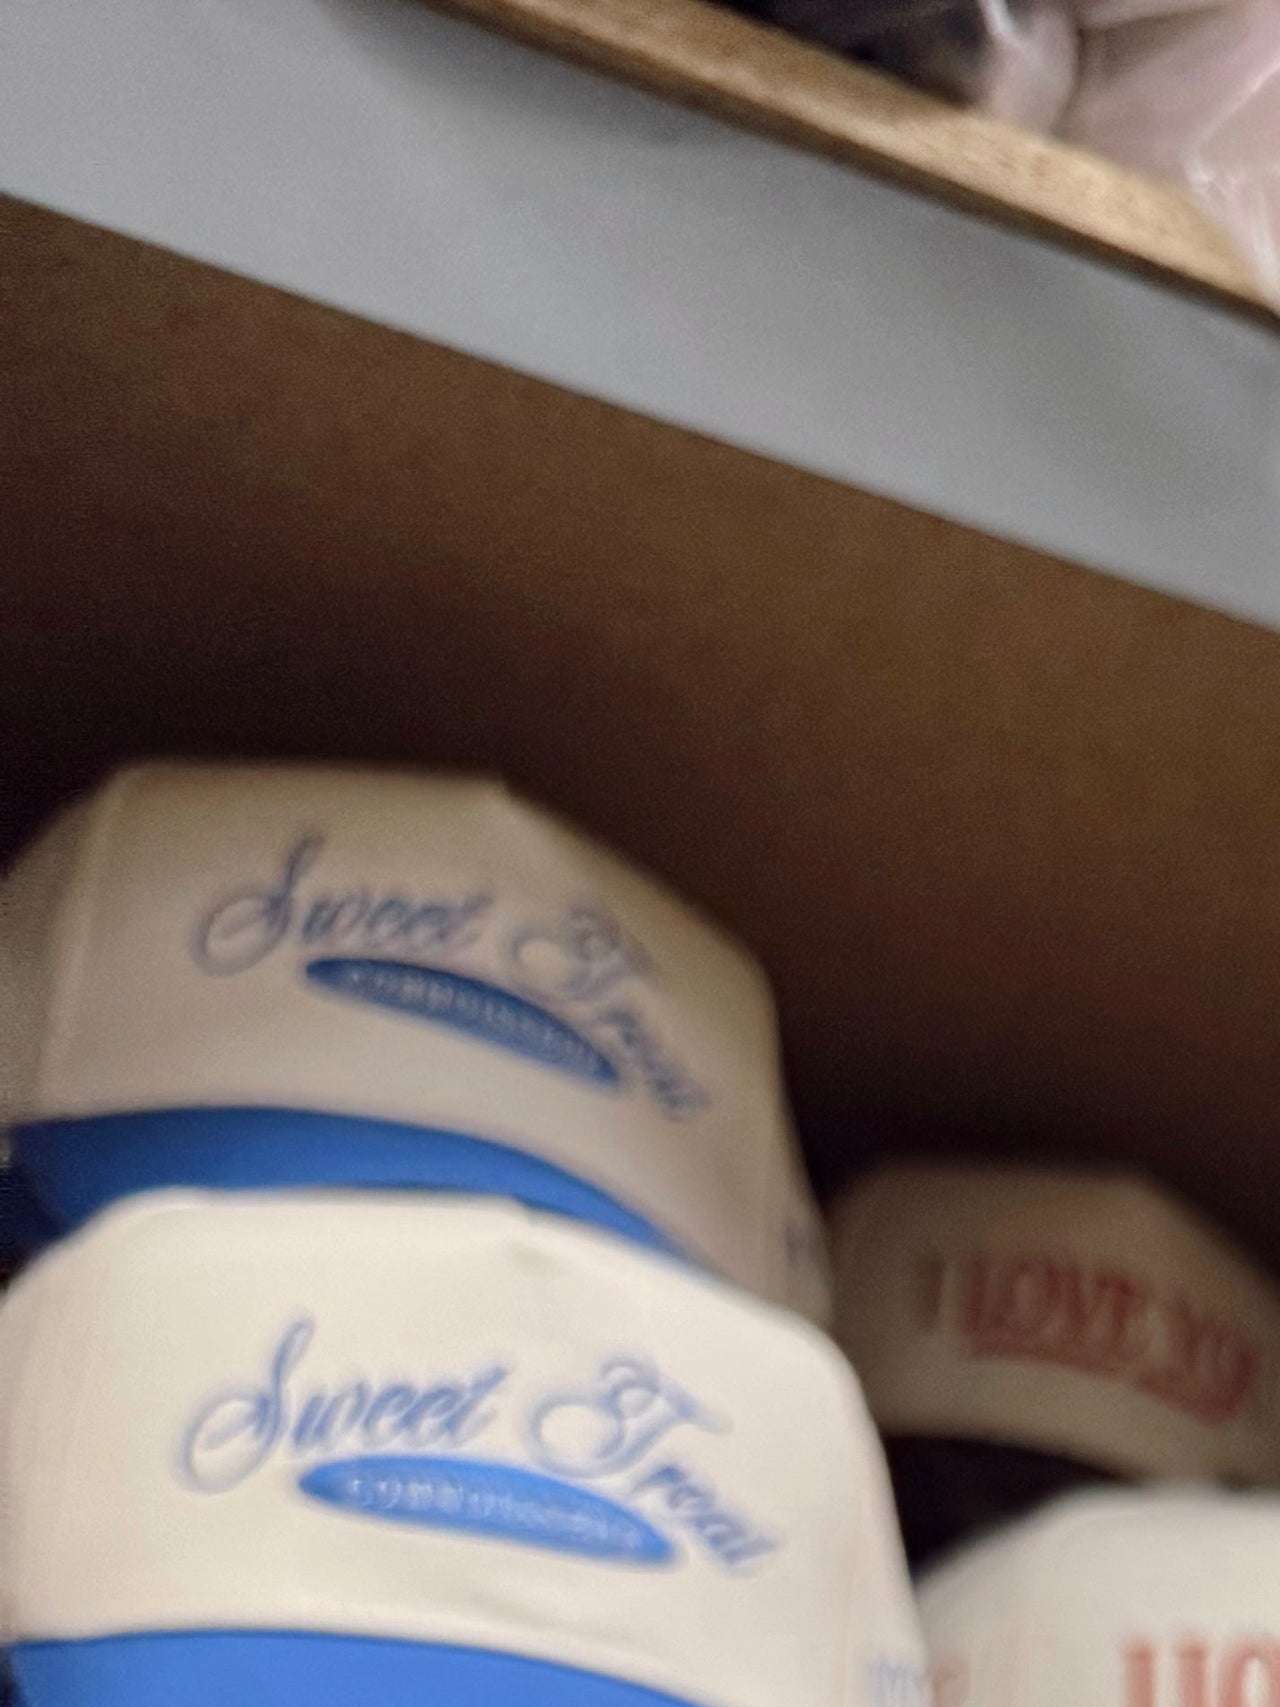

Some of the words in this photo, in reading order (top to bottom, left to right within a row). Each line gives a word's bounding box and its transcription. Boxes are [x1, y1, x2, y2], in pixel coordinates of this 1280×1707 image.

[191, 829, 494, 976] Sweet
[178, 1311, 512, 1493] Sweet
[529, 1356, 778, 1572] Treat
